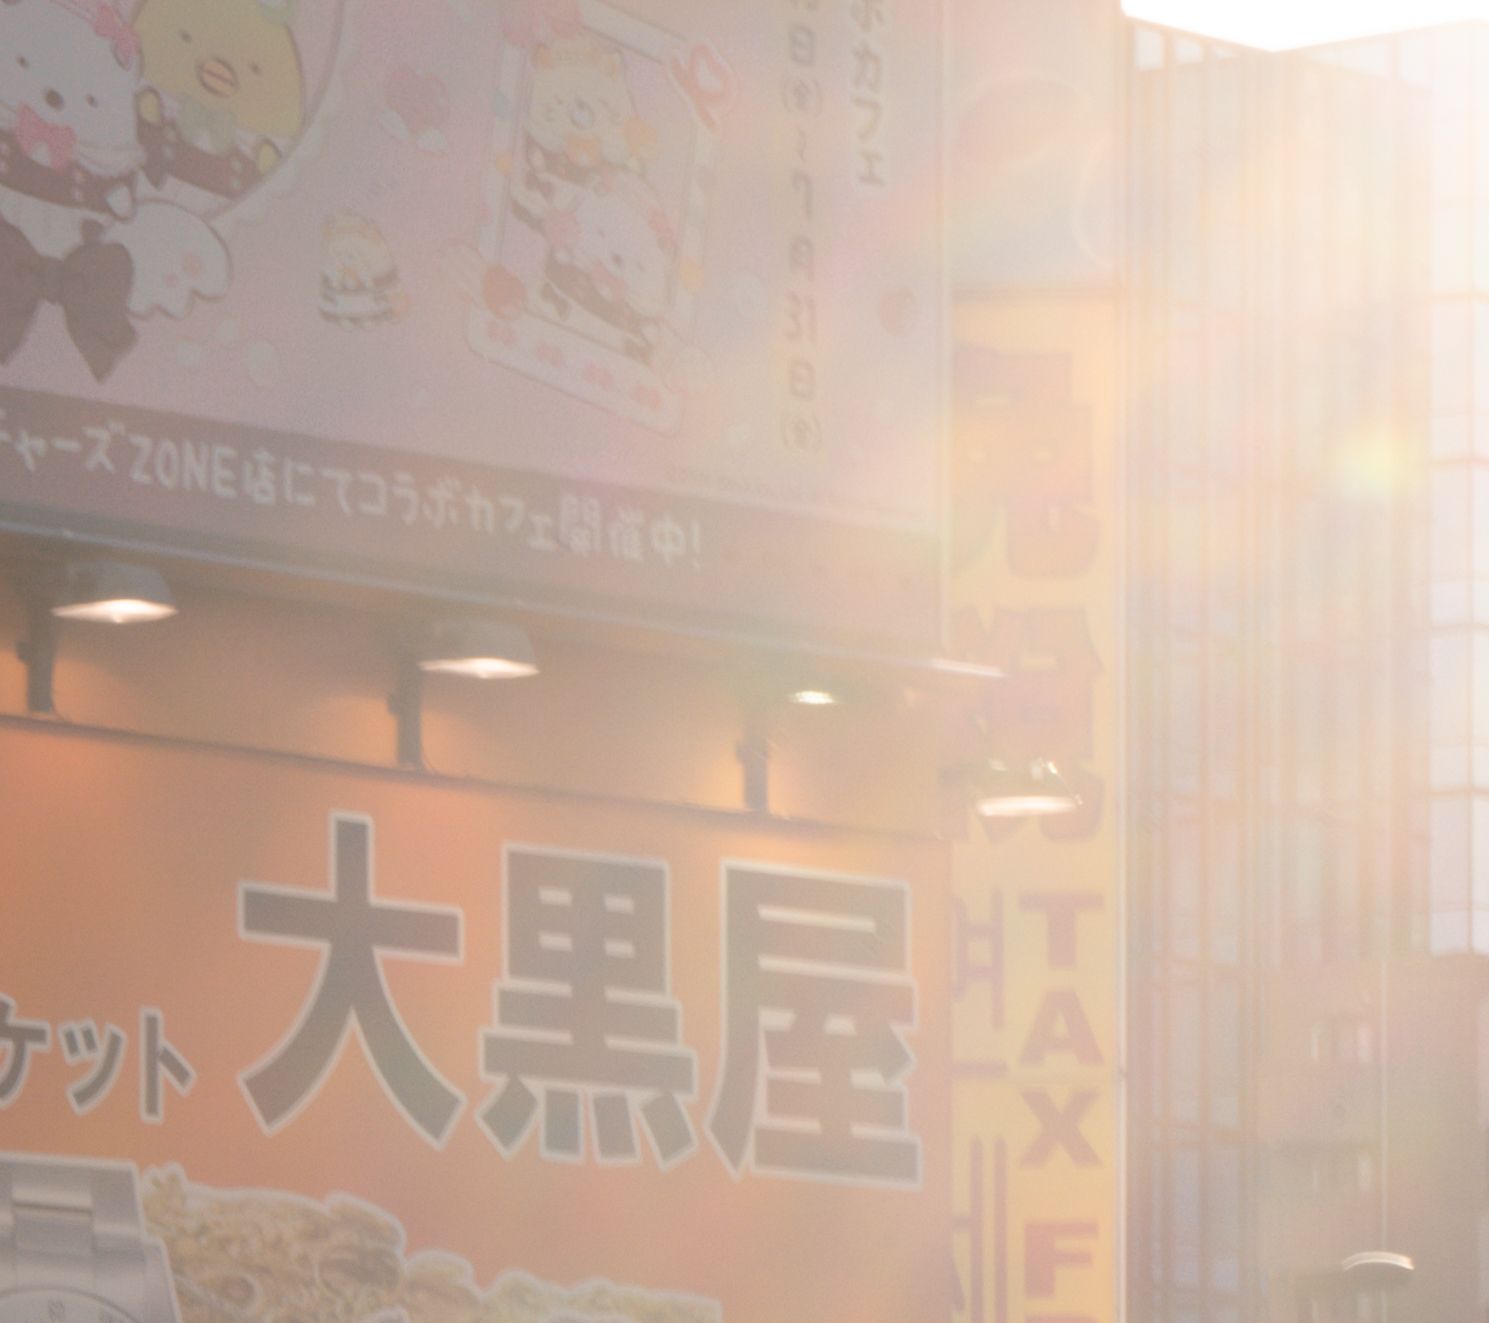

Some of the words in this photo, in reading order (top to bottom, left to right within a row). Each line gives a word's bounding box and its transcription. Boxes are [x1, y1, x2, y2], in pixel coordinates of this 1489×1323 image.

[236, 811, 922, 1188] 大黒屋
[1020, 890, 1107, 1170] TAX
